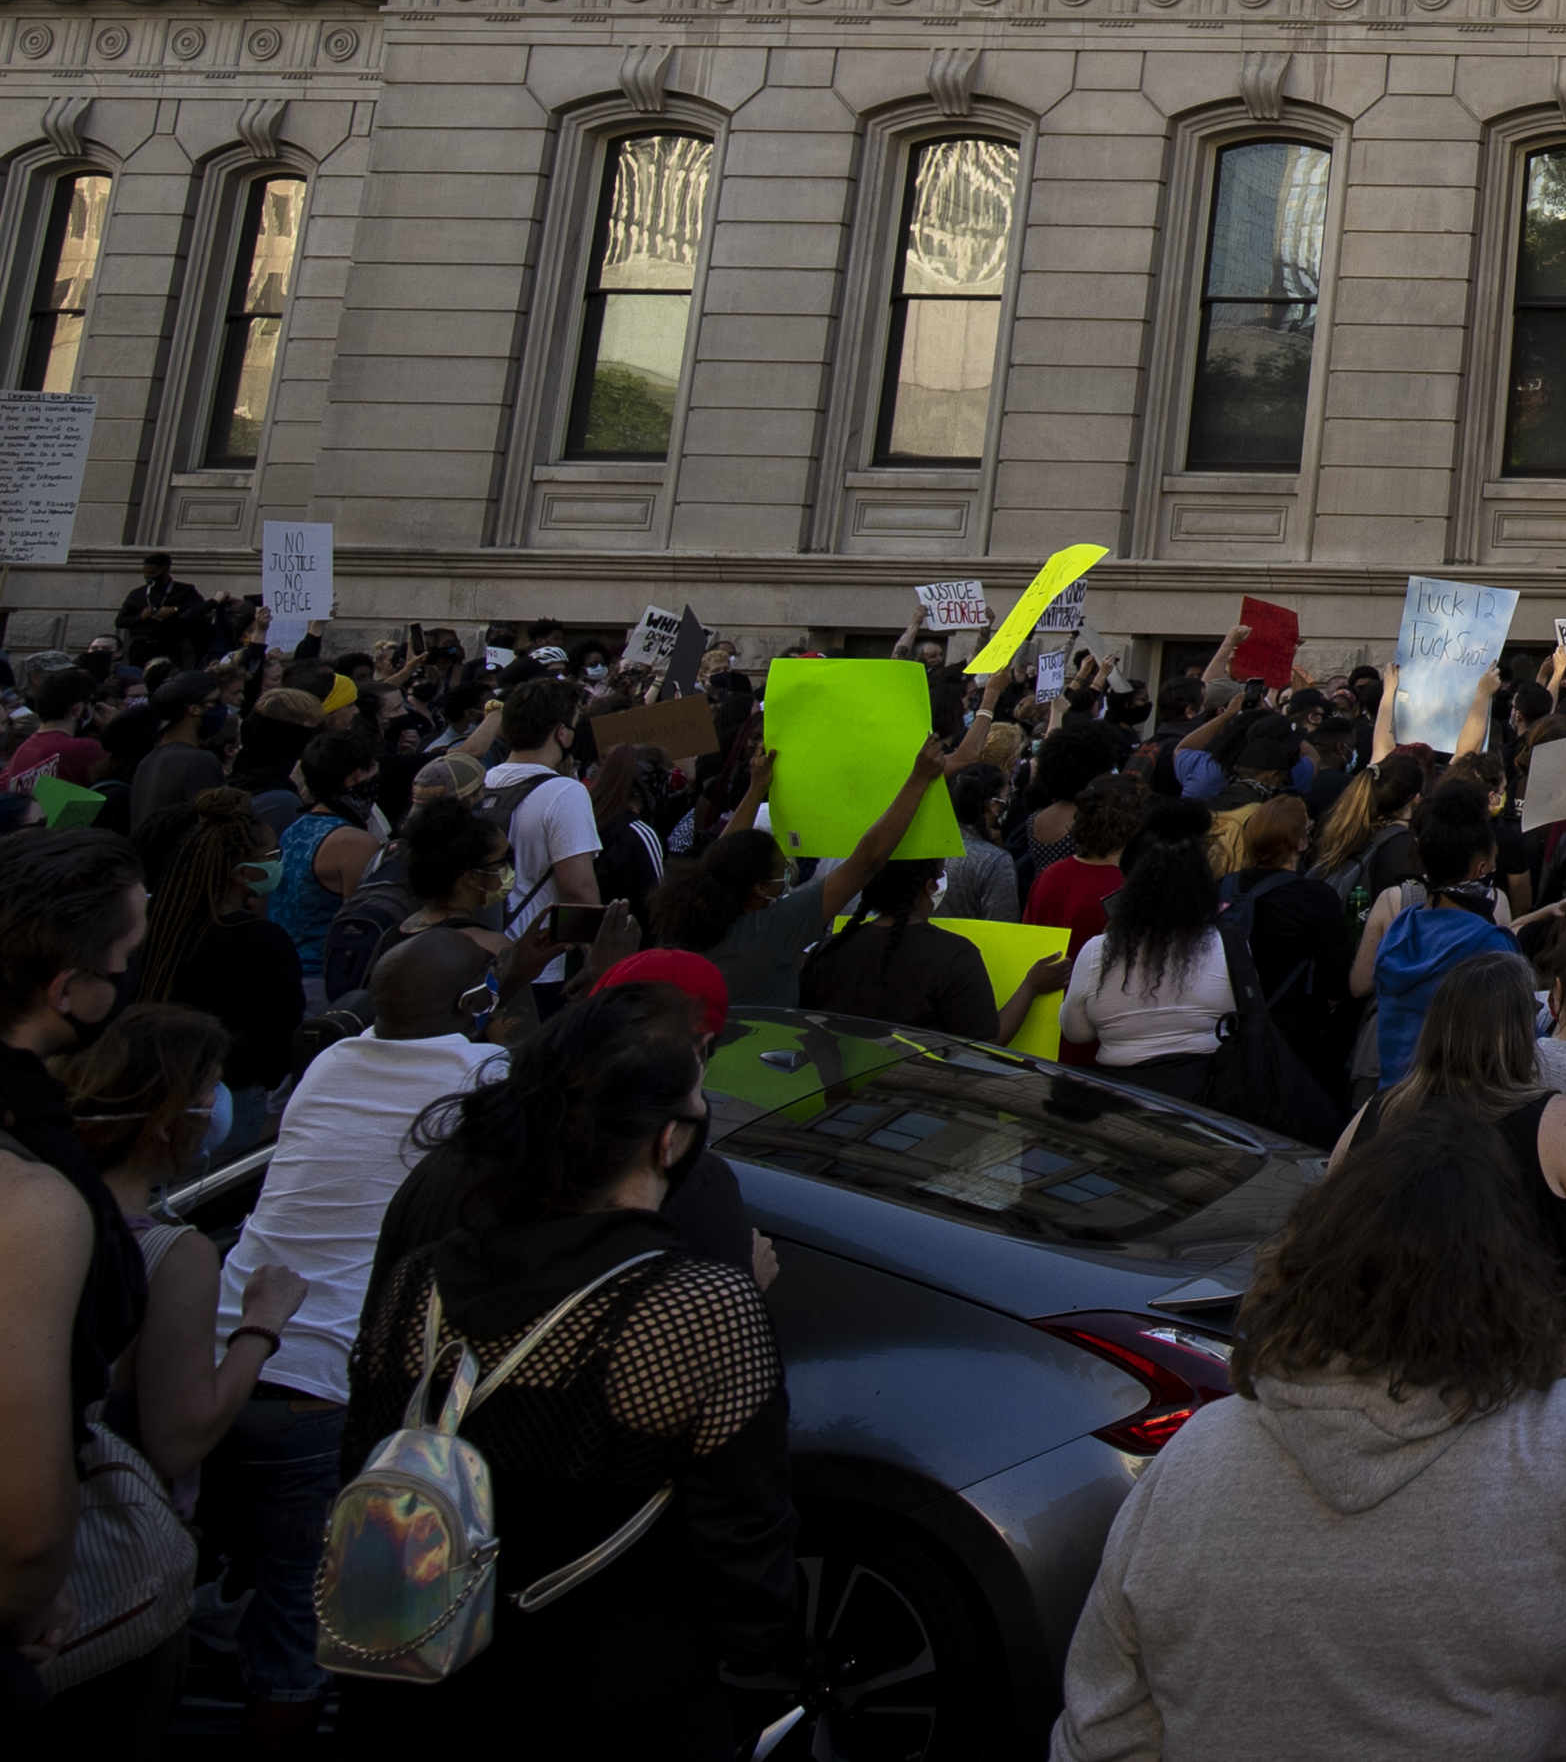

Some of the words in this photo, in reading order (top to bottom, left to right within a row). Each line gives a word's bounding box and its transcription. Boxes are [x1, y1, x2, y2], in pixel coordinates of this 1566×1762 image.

[284, 531, 305, 554] NO
[270, 553, 317, 573] JUSTICE
[284, 573, 303, 592] NO
[923, 581, 977, 602] JUSTICE
[274, 590, 312, 614] PEACE
[937, 599, 988, 625] GEORGE
[1474, 590, 1498, 619] 12
